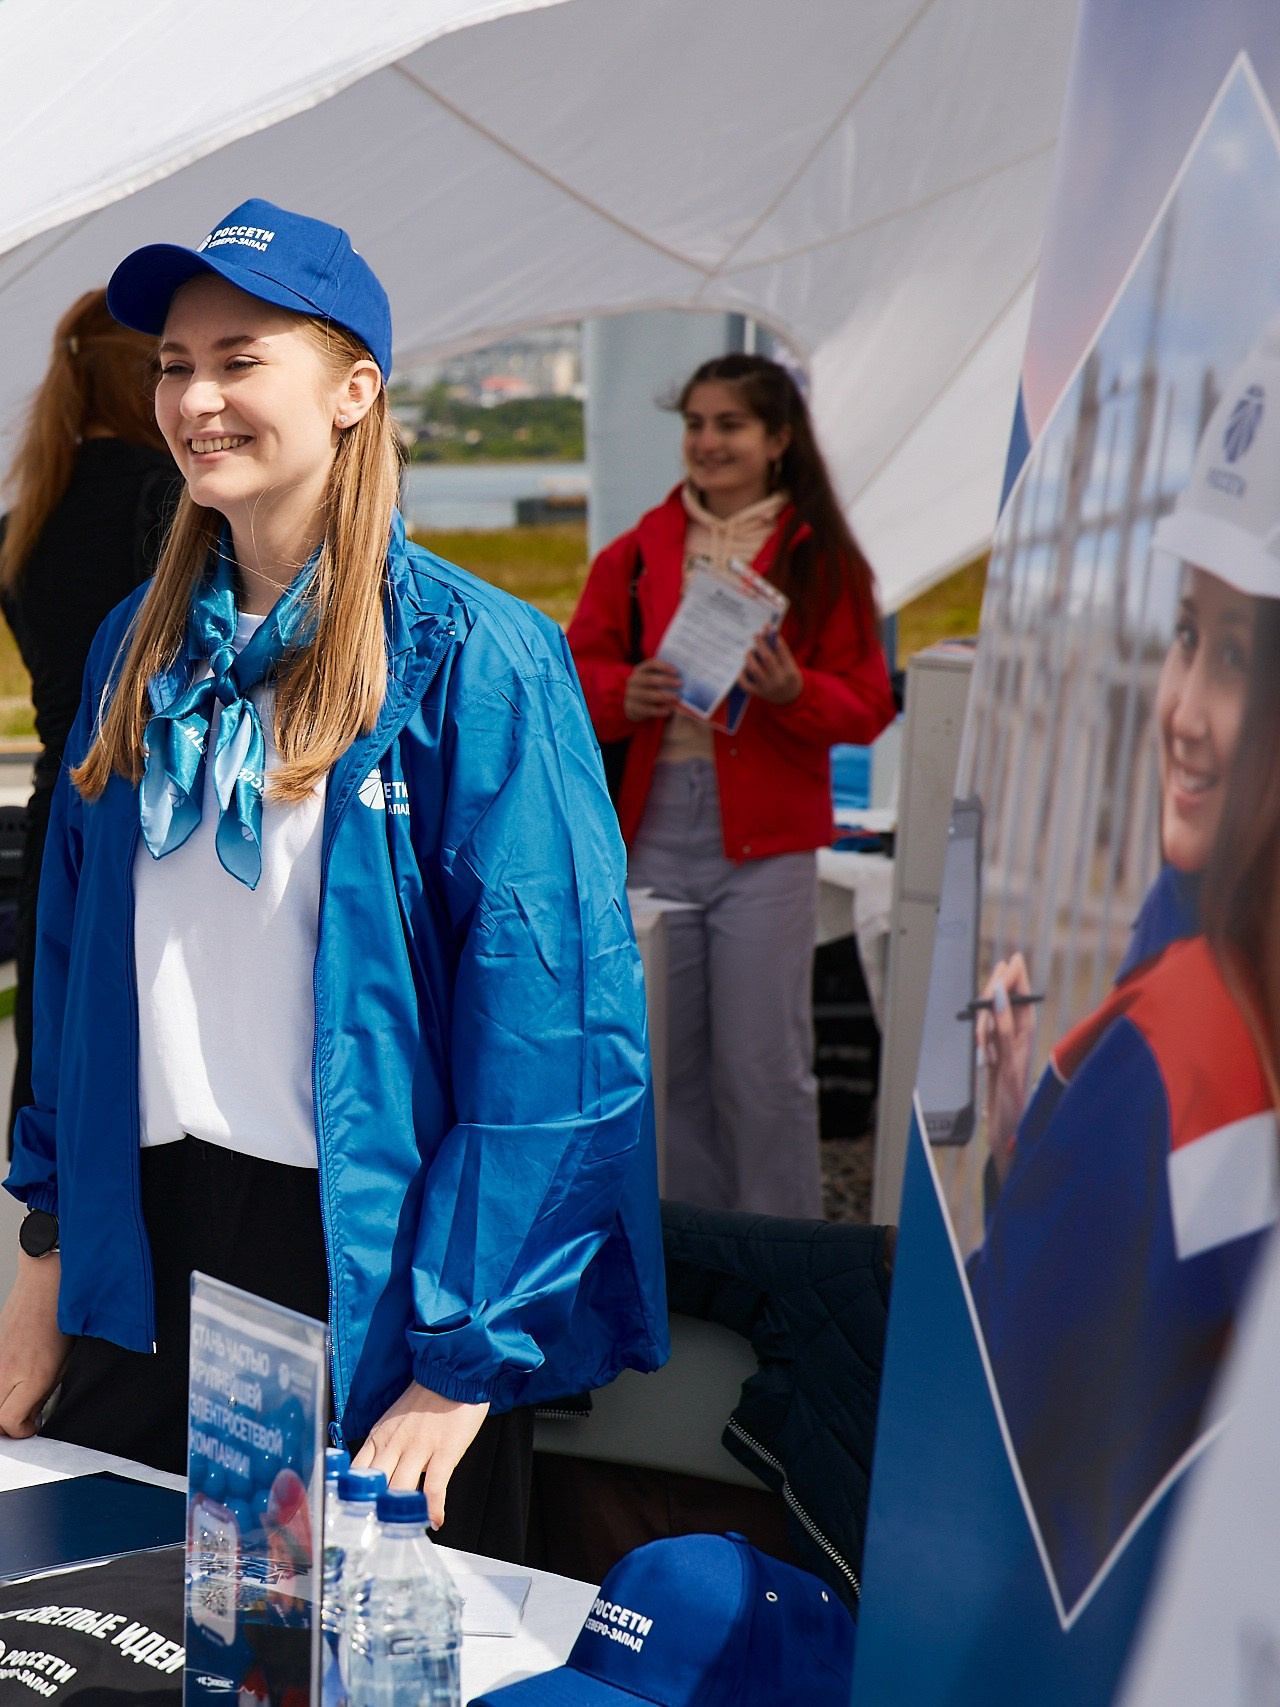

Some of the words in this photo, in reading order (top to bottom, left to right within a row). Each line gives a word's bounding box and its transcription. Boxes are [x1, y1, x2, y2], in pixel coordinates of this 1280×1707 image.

[208, 237, 268, 252] СЕВЕРО-ЗАПАД
[212, 226, 275, 242] РОССЕТИ
[591, 1597, 653, 1637] РОССЕТИ
[0, 1649, 78, 1685] РОССЕТИ
